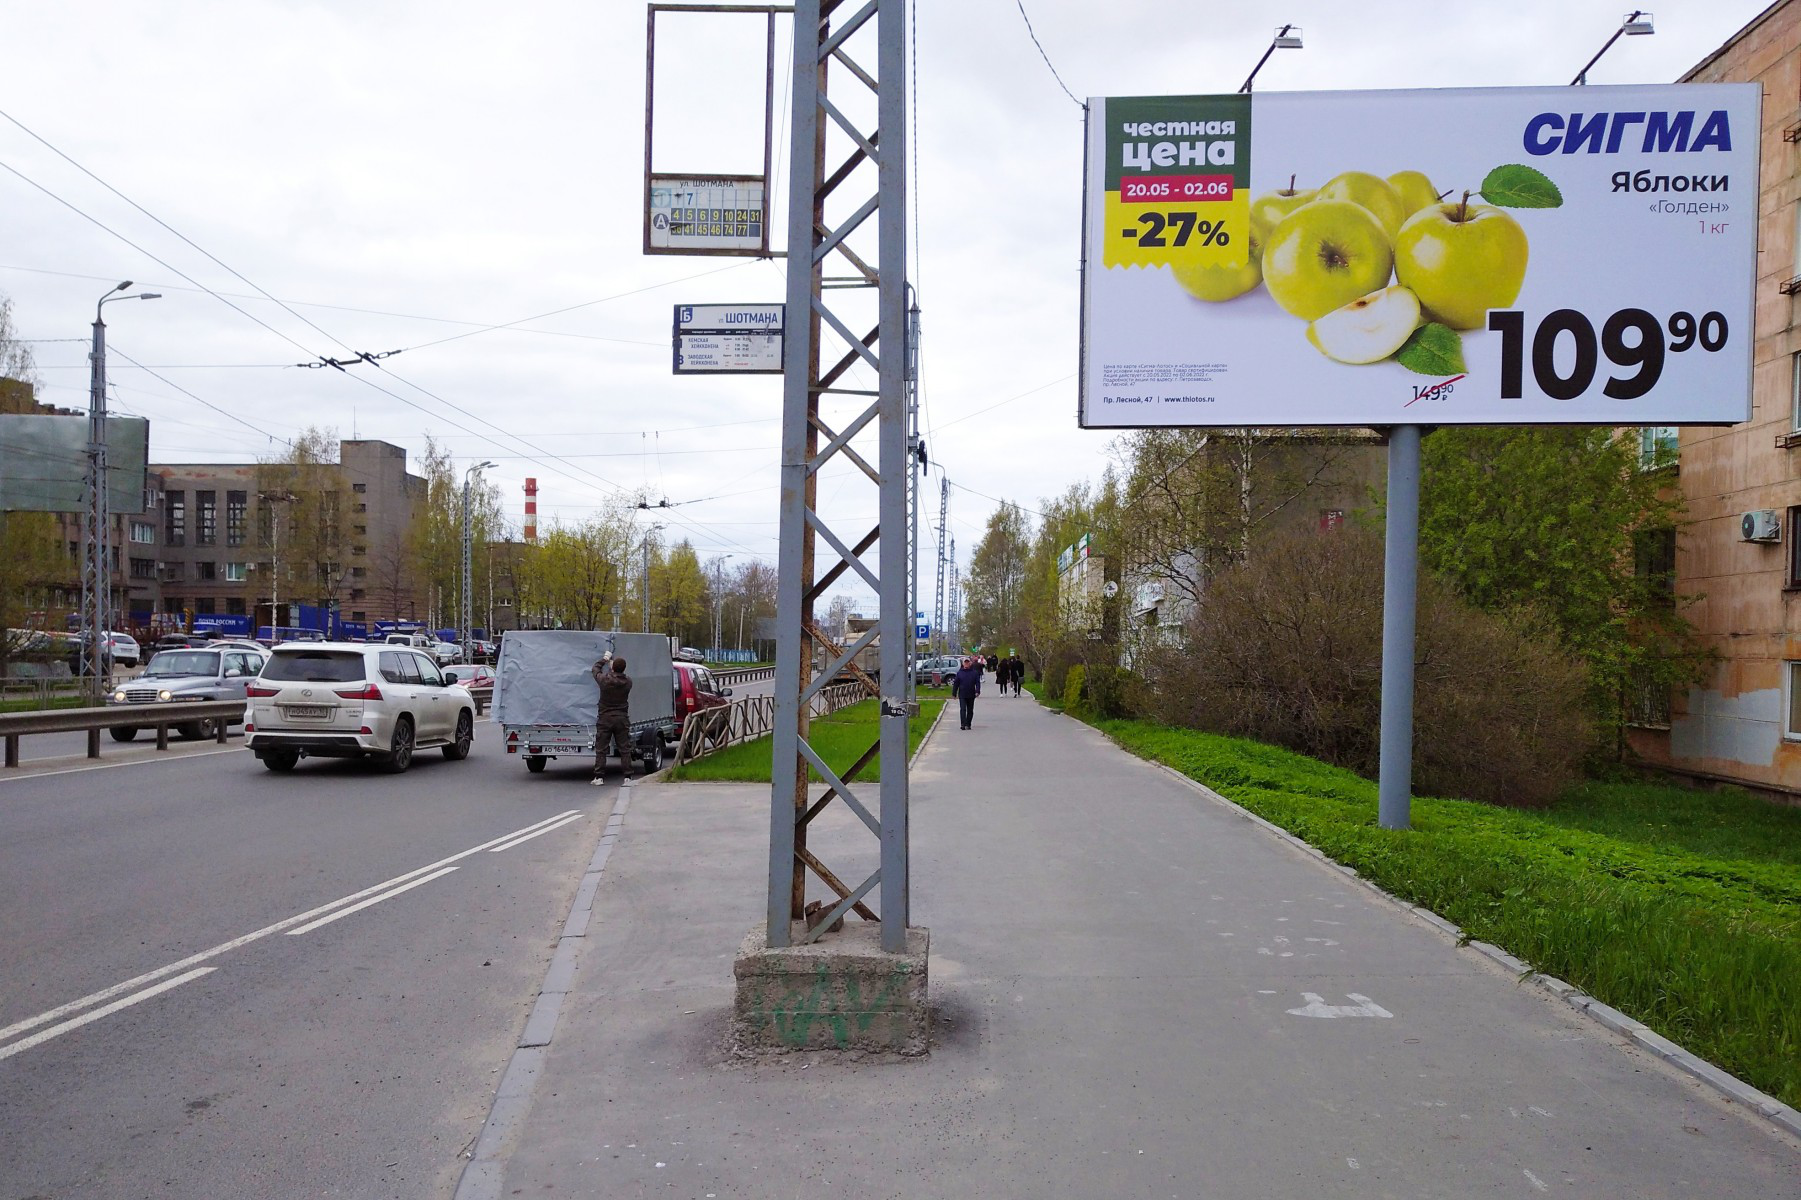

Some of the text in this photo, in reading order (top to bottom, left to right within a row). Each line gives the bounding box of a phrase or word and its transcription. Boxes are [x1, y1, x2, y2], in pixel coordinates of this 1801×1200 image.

[1123, 120, 1236, 137] честная
[1523, 110, 1732, 156] СИГМА
[1122, 140, 1236, 172] цена
[692, 180, 734, 188] ШОТМАНА
[1611, 169, 1729, 193] Яблоки
[1127, 183, 1170, 196] 20.05
[1184, 182, 1228, 195] 02.06
[687, 192, 693, 205] 7
[1649, 200, 1730, 216] «Голден»
[674, 210, 759, 221] 4 5 6 9 10 24 31
[685, 224, 694, 235] 41
[697, 224, 707, 235] 45
[711, 225, 720, 235] 46
[724, 225, 733, 235] 74
[737, 225, 747, 235] 77
[1122, 212, 1230, 248] -27%
[1699, 220, 1730, 234] 1 кг
[725, 312, 778, 323] ШОТМАНА
[1115, 396, 1143, 404] Лесной,
